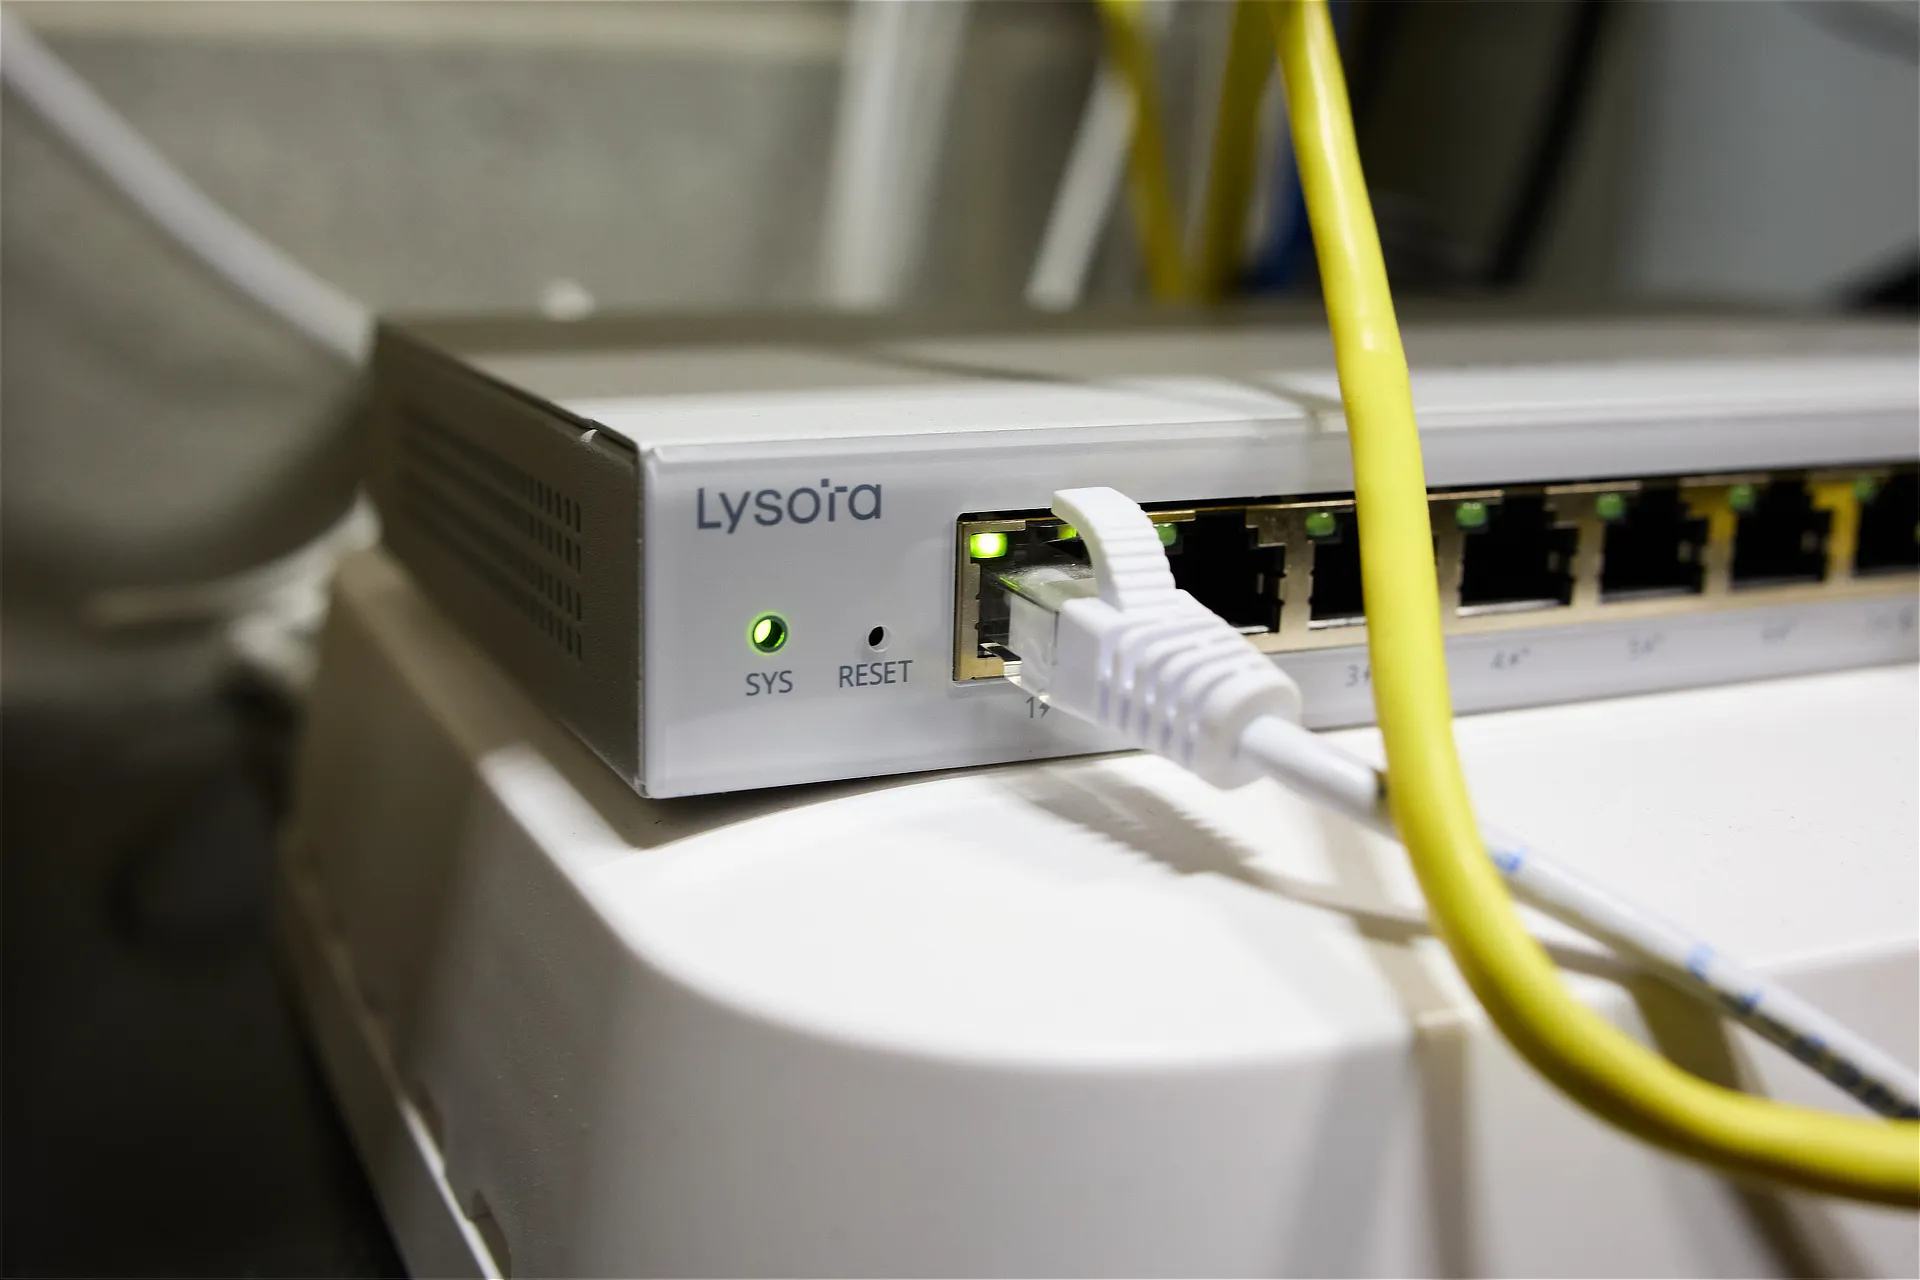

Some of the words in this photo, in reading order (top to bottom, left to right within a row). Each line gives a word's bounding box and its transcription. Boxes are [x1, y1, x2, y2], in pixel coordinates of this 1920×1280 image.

[697, 478, 882, 535] Lysora
[745, 669, 794, 697] SYS
[838, 659, 914, 689] RESET
[1345, 663, 1360, 688] 3
[1025, 695, 1035, 719] 1
